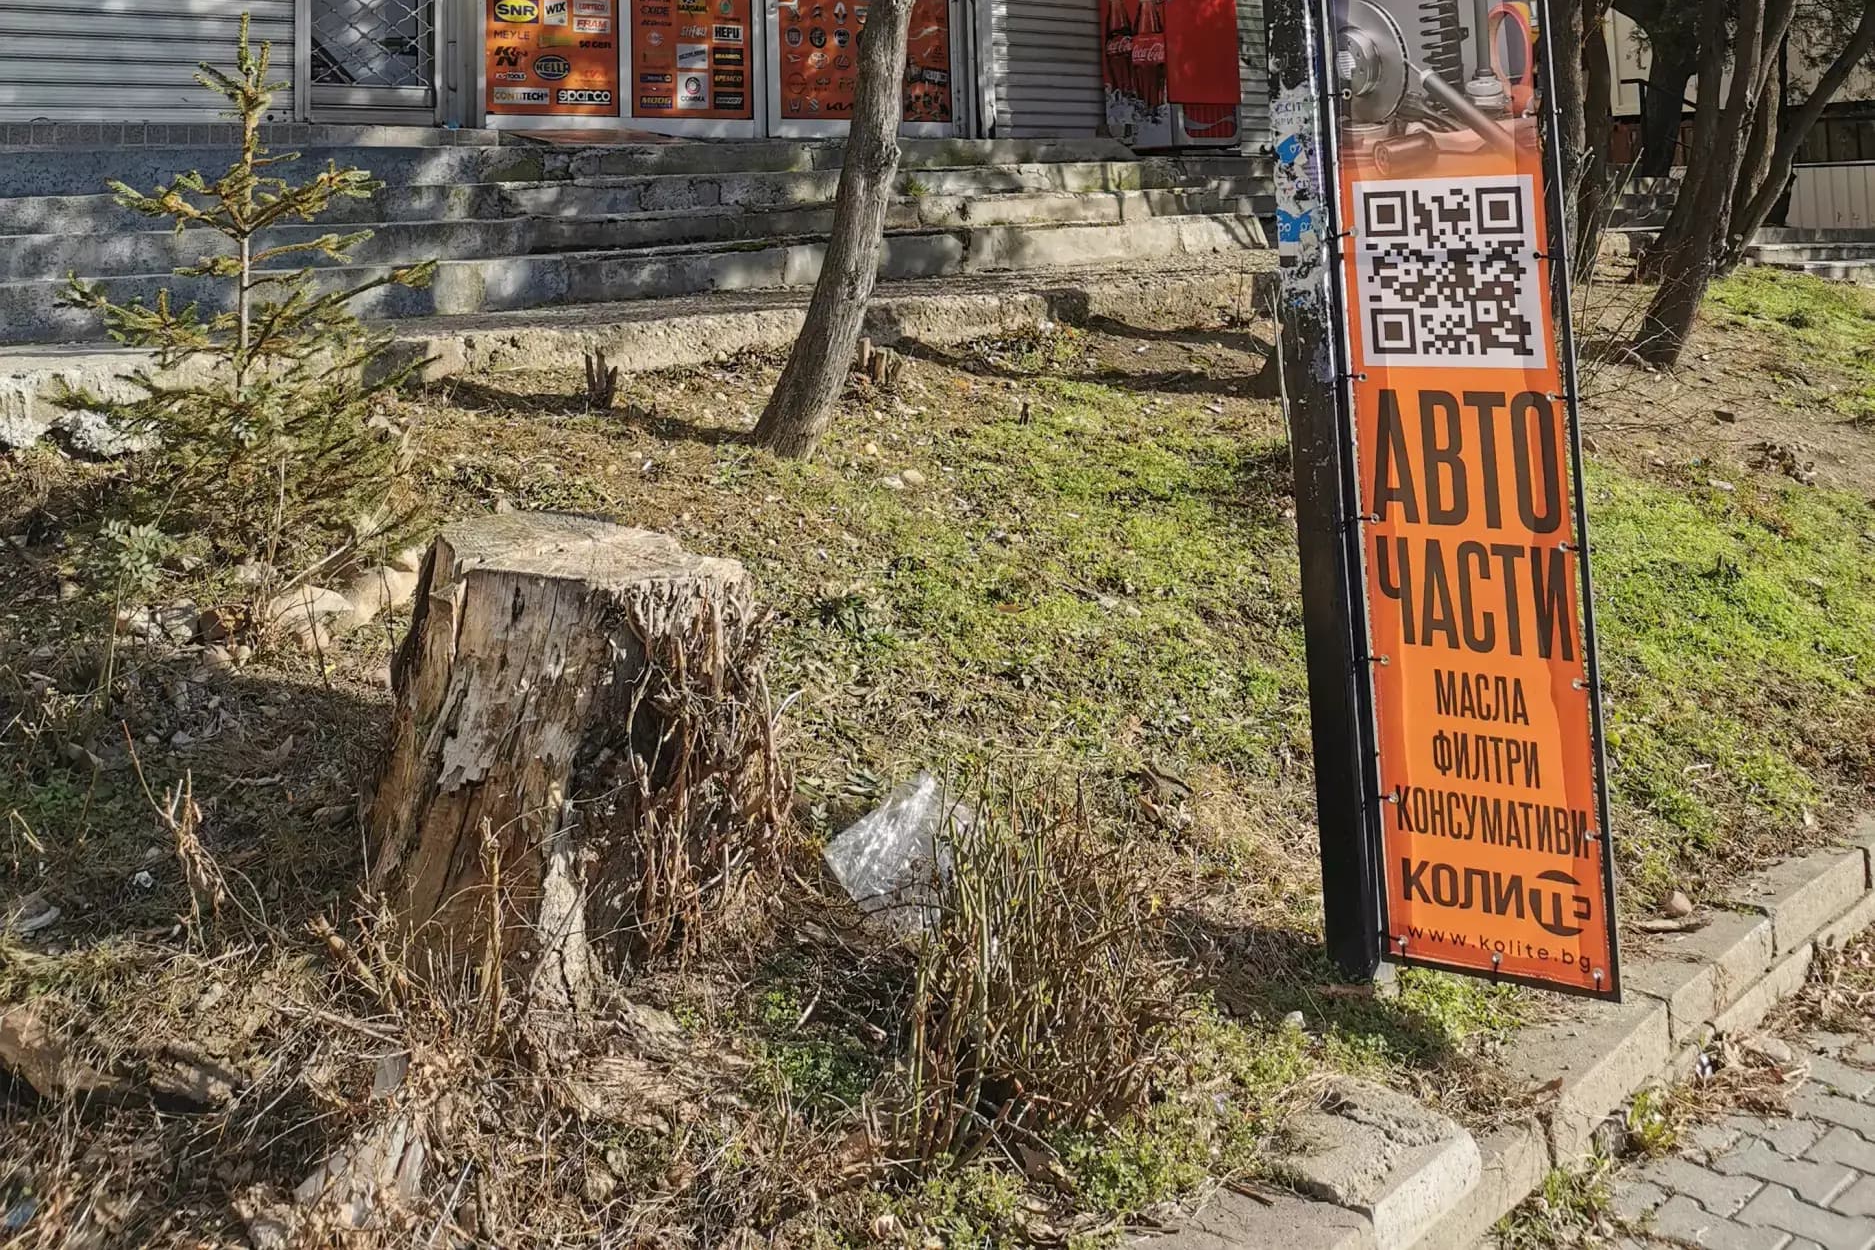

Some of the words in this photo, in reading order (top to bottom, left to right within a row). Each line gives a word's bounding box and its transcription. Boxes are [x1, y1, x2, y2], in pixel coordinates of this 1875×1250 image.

[496, 3, 536, 17] SNR
[545, 1, 567, 16] WIX
[576, 19, 608, 29] FRAM
[493, 29, 530, 41] MEYLE
[714, 26, 740, 40] HEPU
[557, 90, 611, 104] sparco
[1371, 388, 1563, 534] АВТО
[1375, 535, 1575, 663] ЧАСТИ
[1433, 668, 1530, 727] МАСЛА
[1431, 729, 1542, 790] ФИЛТРИ
[1395, 784, 1590, 860] КОНСУМАТИВИ
[1407, 924, 1592, 974] www.kolite.bg
